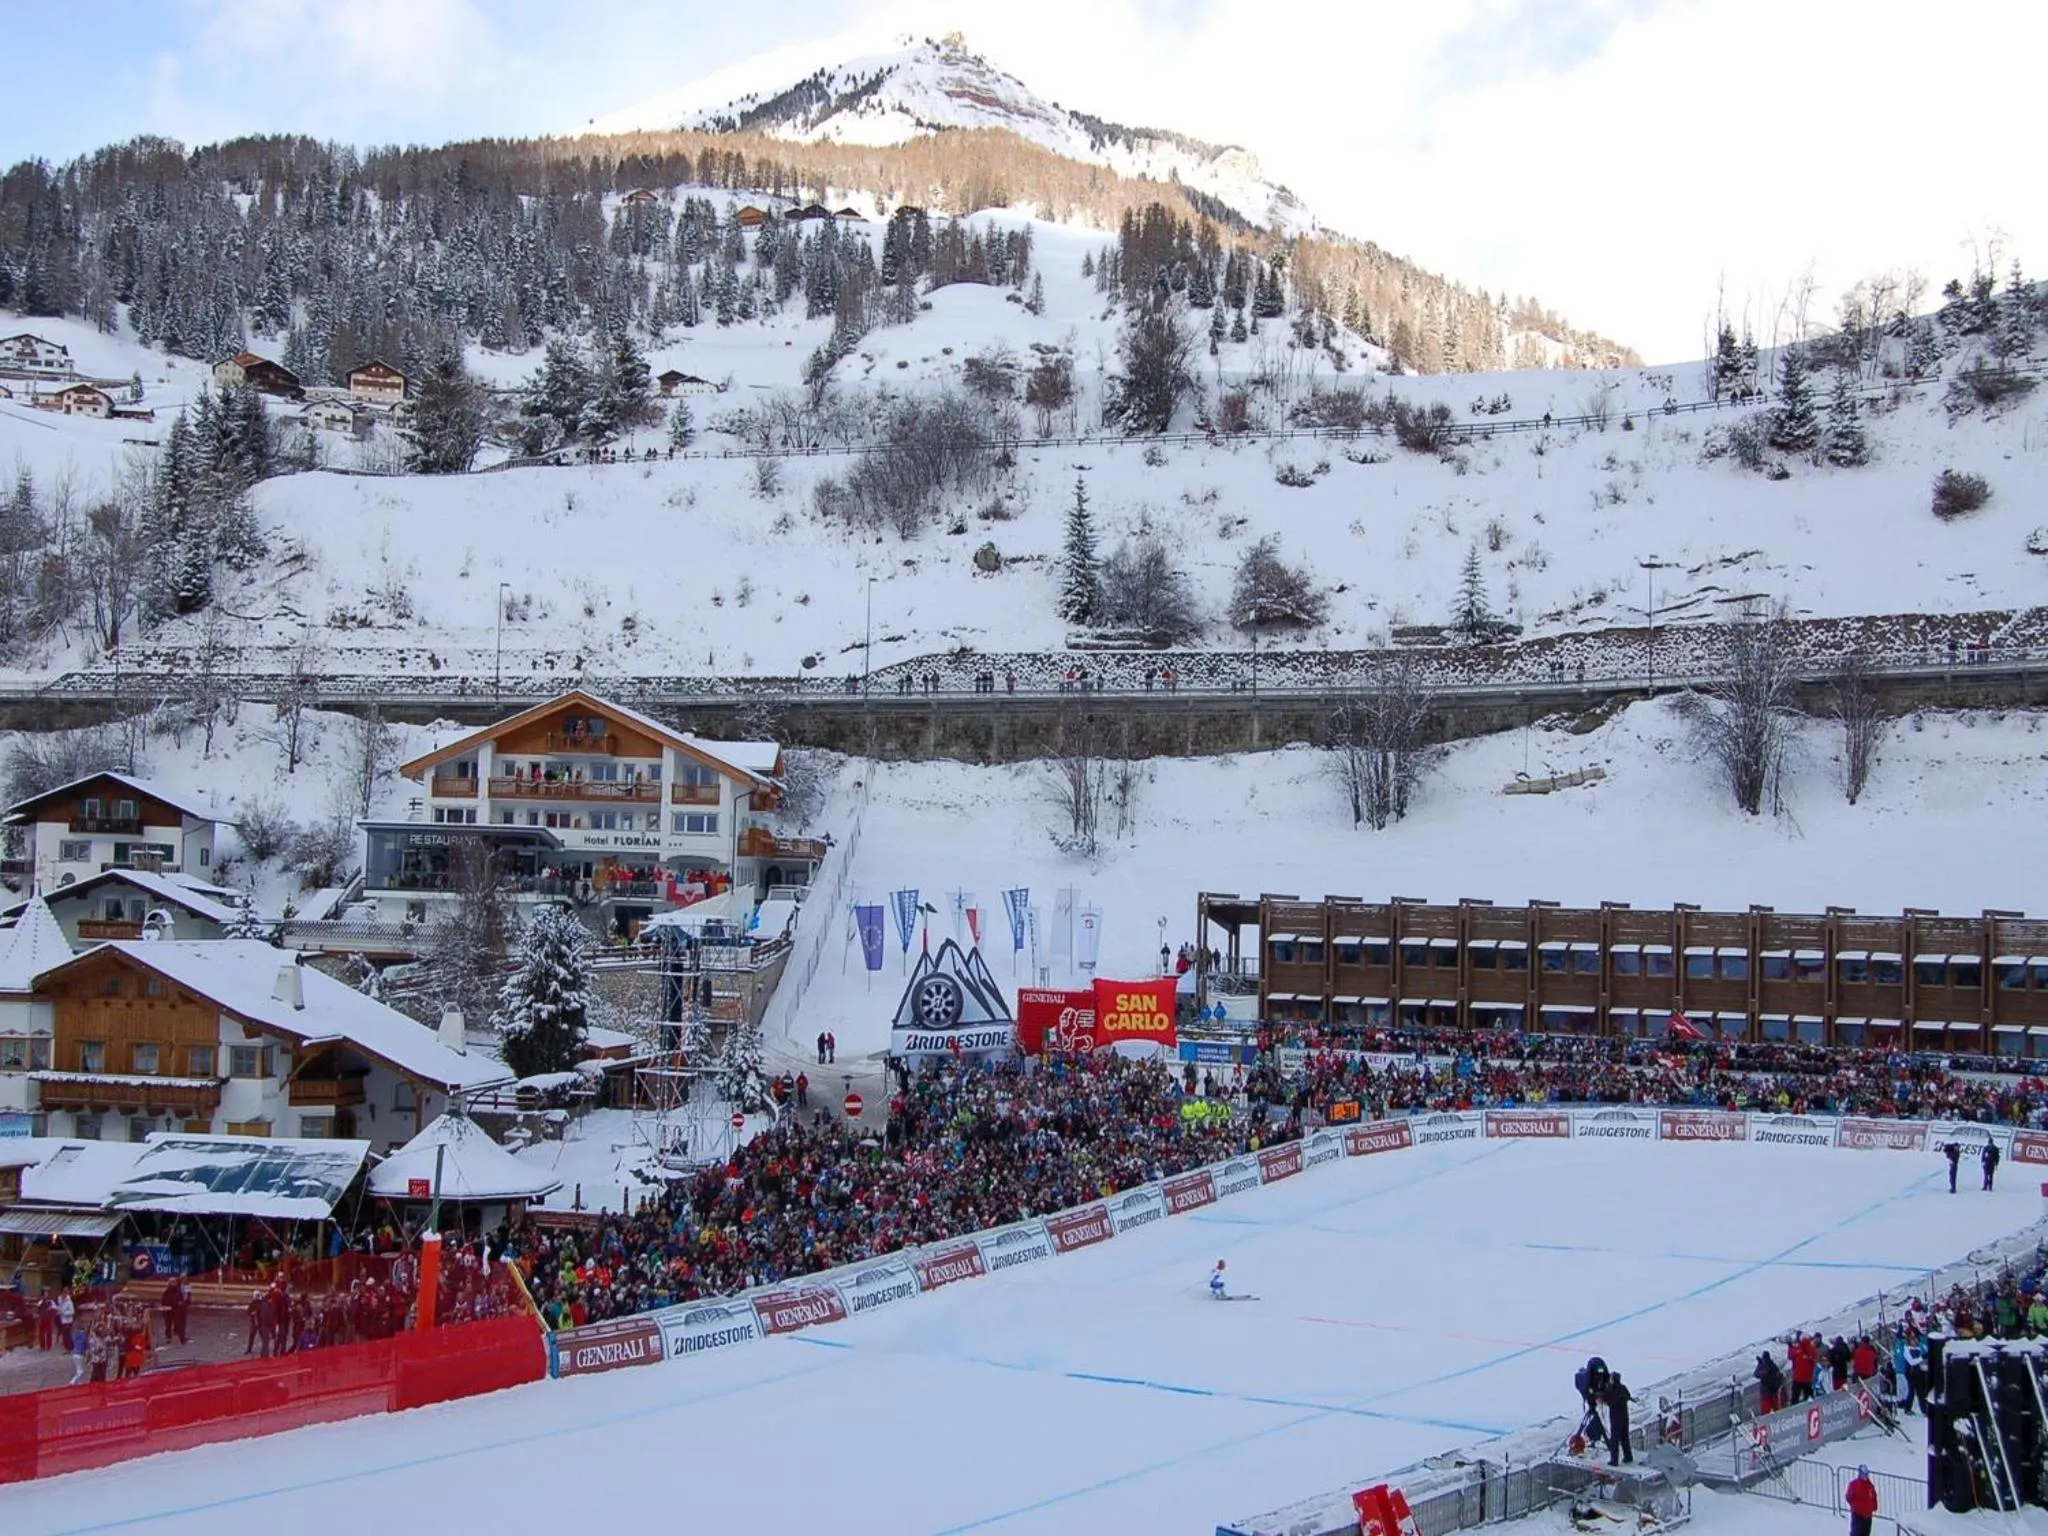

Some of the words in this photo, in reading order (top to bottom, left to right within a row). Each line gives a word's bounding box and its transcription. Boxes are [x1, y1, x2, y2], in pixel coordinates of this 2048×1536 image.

[409, 834, 480, 847] RESTAURANT
[584, 835, 609, 846] Hotel
[614, 835, 660, 847] FLORIAN
[1022, 993, 1066, 1004] GENERALI
[1116, 993, 1157, 1012] SAN
[1103, 1012, 1169, 1031] CARLO
[905, 1031, 1008, 1051] BRIDGESTONE
[1419, 1128, 1477, 1144] BRIDGESTONE
[1500, 1120, 1556, 1134] GENERALI
[1578, 1126, 1650, 1138] BRIDGESTONE
[1675, 1124, 1731, 1138] GENERALI
[1358, 1132, 1400, 1151] GENERALI
[1755, 1130, 1830, 1146] BRIDGESTONE
[1854, 1132, 1910, 1147] GENERALI
[1175, 1186, 1207, 1209] GENERALI
[1117, 1207, 1162, 1234] BRIDGESTONE
[1062, 1221, 1103, 1247] GENERALI
[991, 1245, 1048, 1271] BRIDGESTONE
[929, 1259, 972, 1284] GENERALI
[852, 1280, 913, 1312] BRIDGESTONE
[775, 1297, 830, 1328] GENERALI
[673, 1324, 754, 1356] BRIDGESTONE
[576, 1338, 644, 1368] GENERALI
